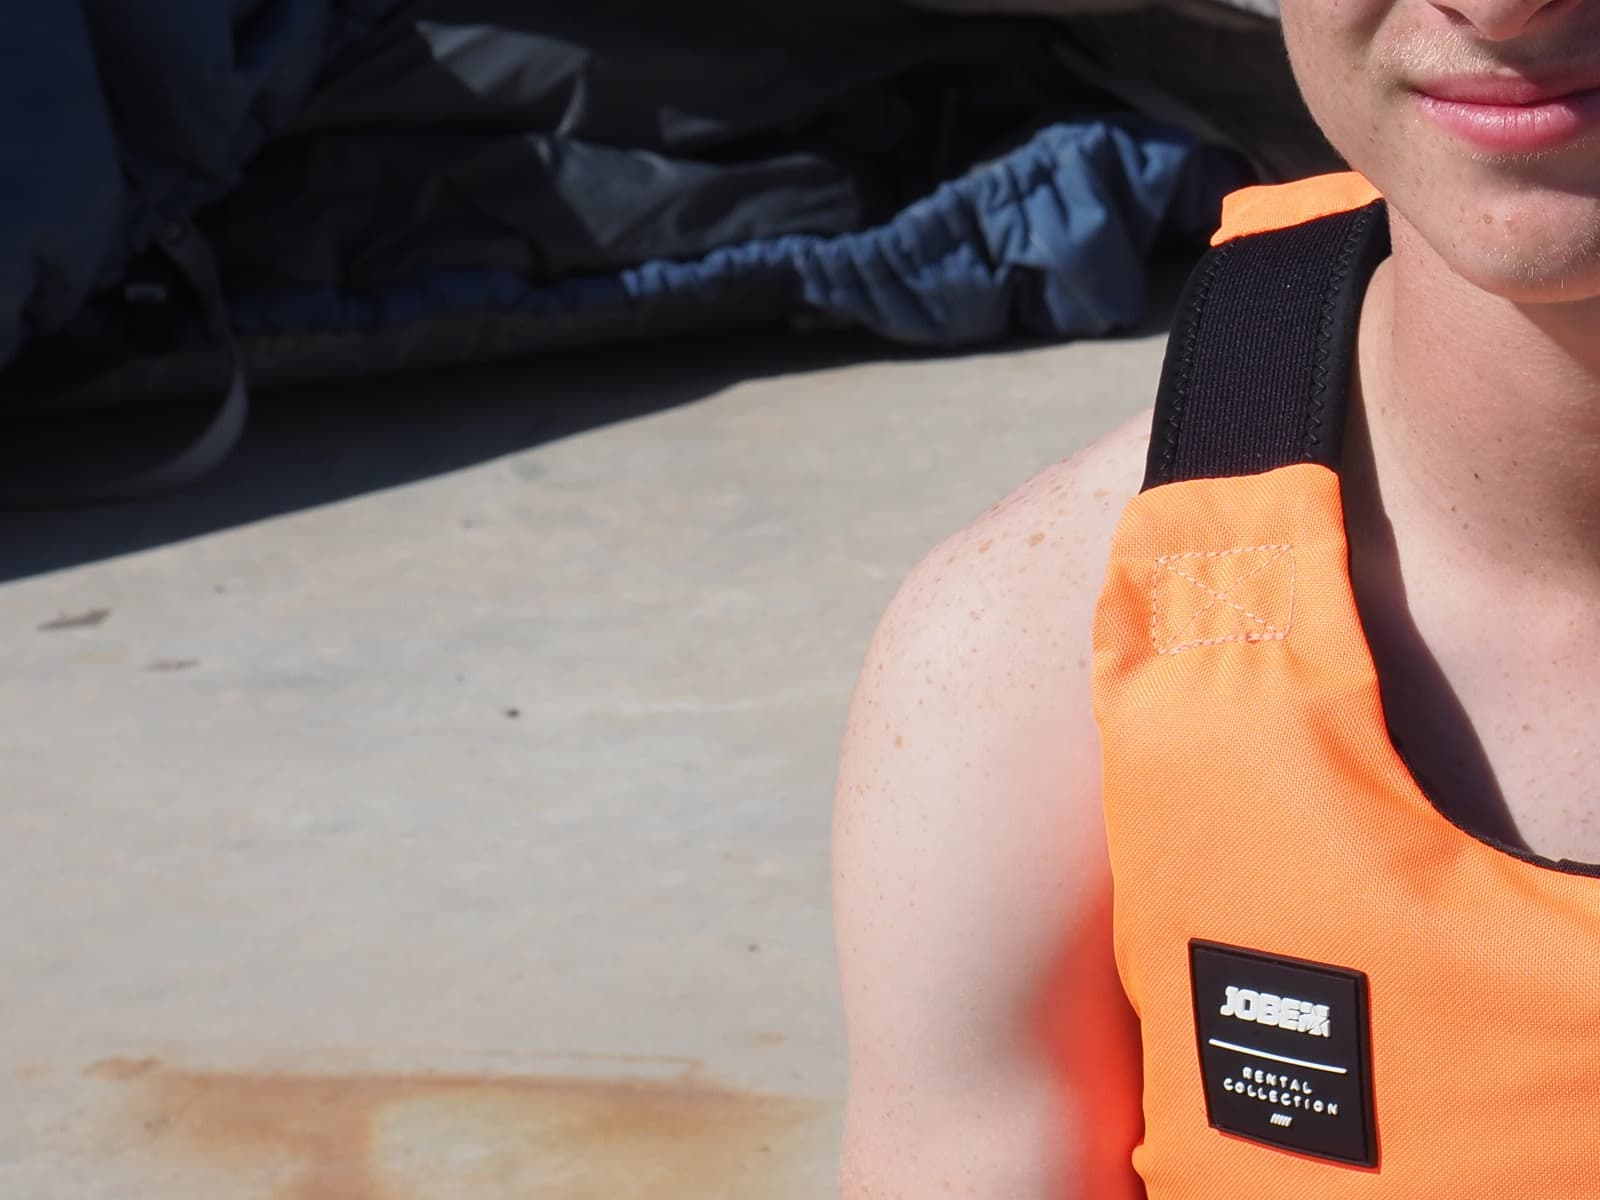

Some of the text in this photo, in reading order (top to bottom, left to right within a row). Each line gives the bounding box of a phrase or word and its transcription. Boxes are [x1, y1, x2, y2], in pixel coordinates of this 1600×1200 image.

[1220, 985, 1300, 1031] JOBE
[1223, 1077, 1338, 1115] COLLECTION
[1242, 1066, 1312, 1094] RENTAL
